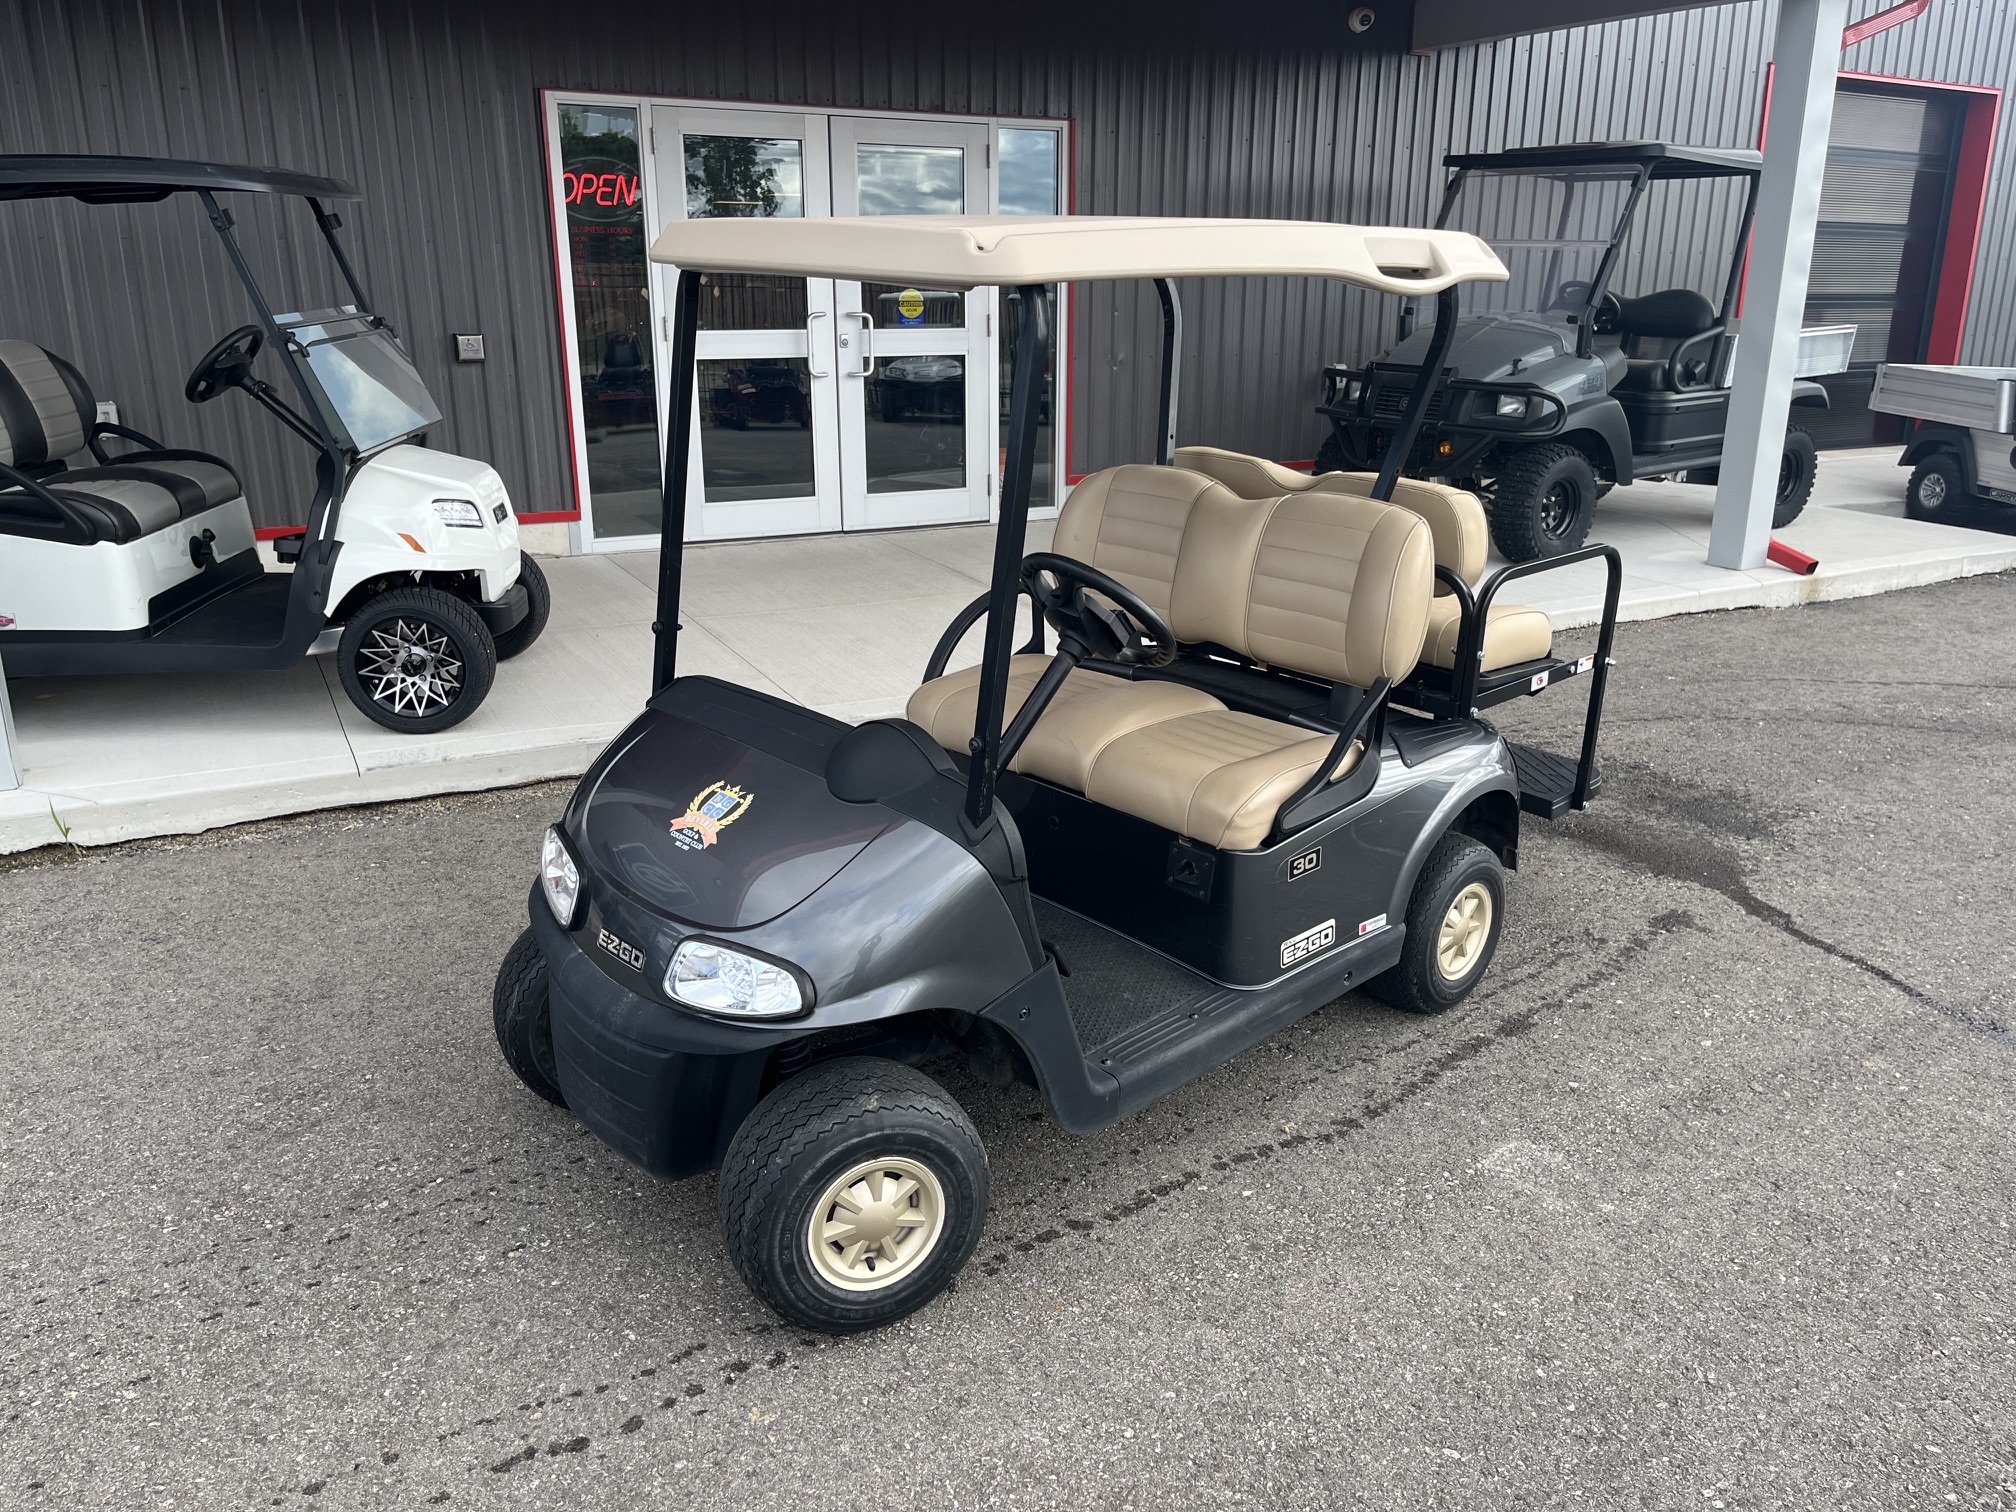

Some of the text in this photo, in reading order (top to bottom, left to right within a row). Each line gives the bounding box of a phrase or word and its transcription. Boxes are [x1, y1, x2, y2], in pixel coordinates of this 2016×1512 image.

[563, 172, 638, 206] OPEN
[570, 226, 634, 235] BUSINESS HOURS
[685, 815, 716, 834] BEVERLY
[1293, 853, 1317, 875] 30
